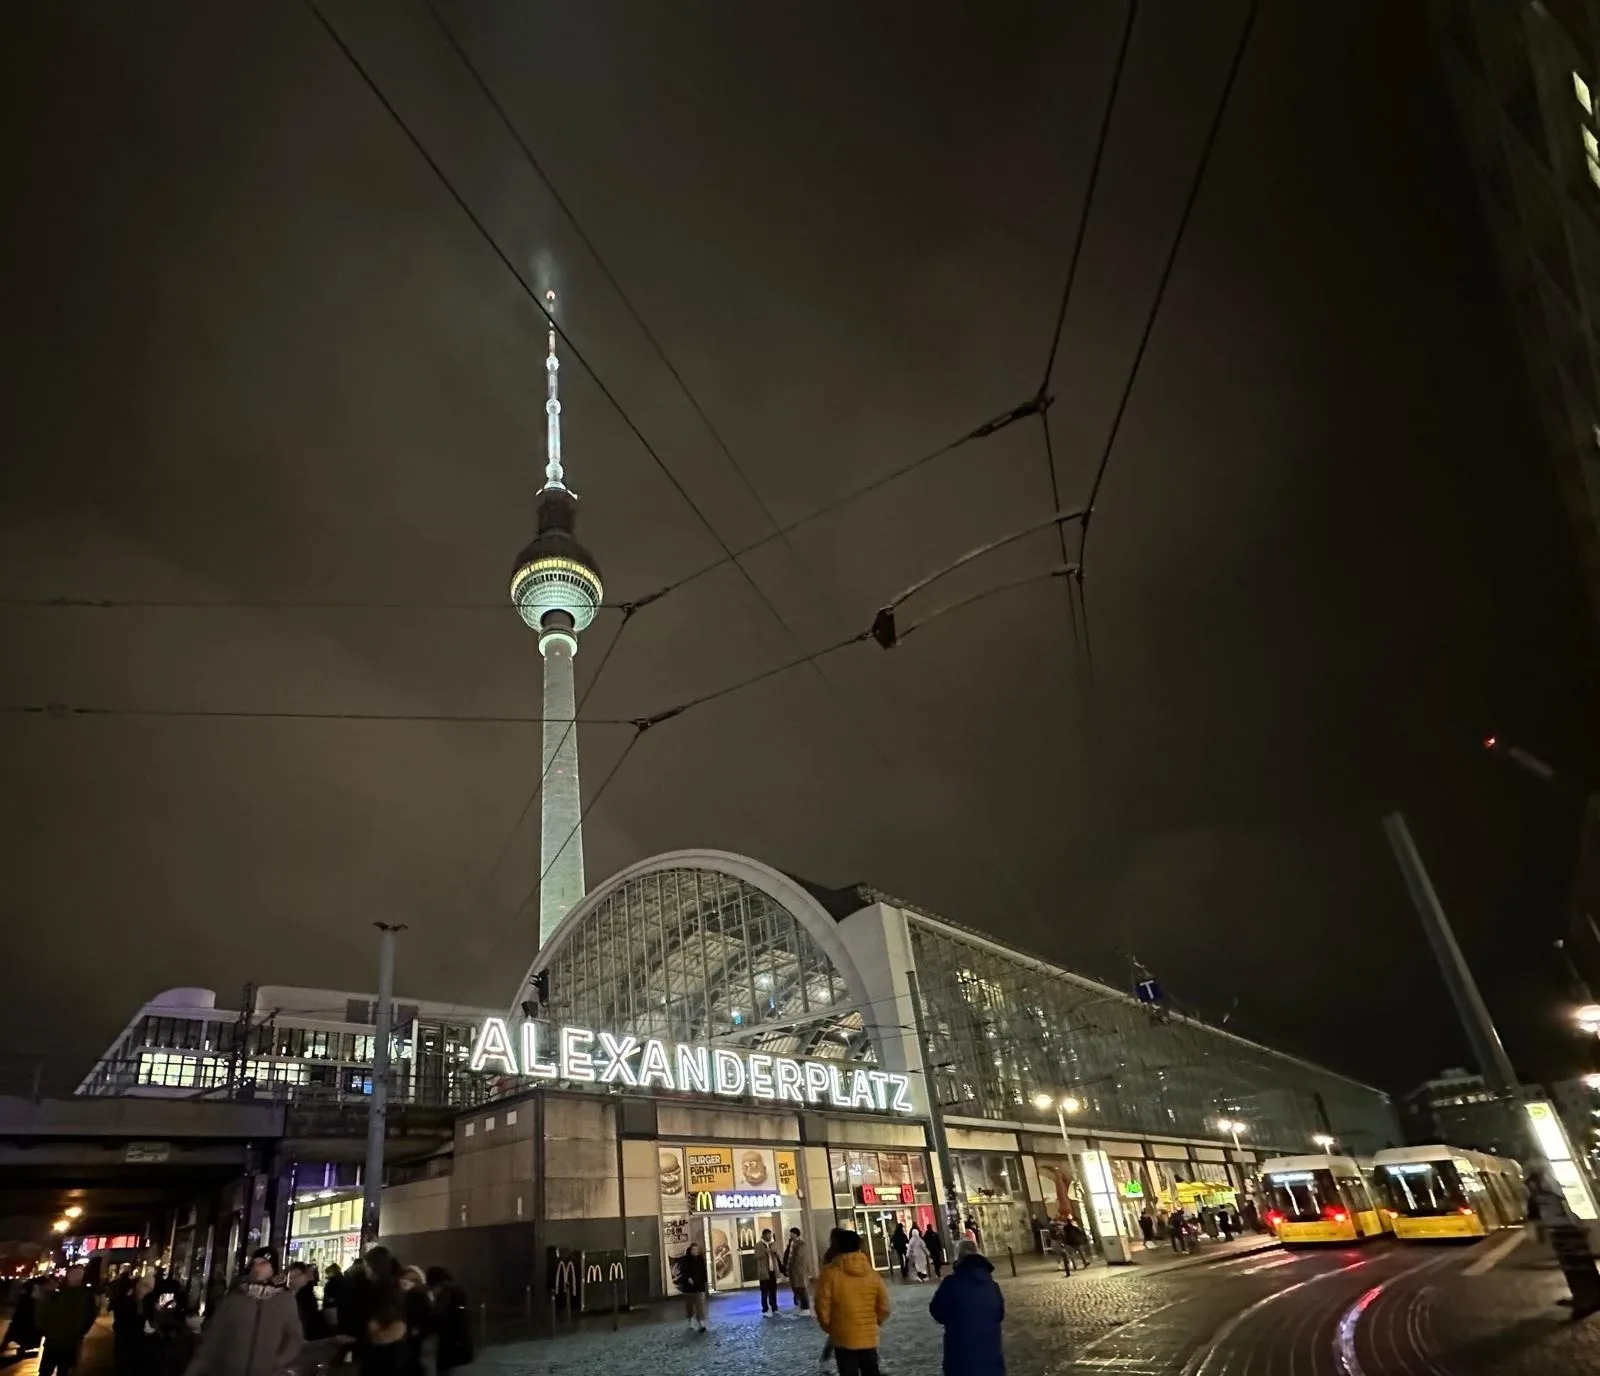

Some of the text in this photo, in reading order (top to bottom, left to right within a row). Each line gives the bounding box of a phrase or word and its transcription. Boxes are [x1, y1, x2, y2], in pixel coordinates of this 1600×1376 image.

[470, 1016, 913, 1112] ALEXANDERPLATZ
[689, 1155, 721, 1165] BURGER
[690, 1164, 731, 1175] FÜR MITTE?
[779, 1169, 795, 1177] LIEBE
[691, 1175, 715, 1184] BITTE!
[715, 1193, 783, 1209] McDonald's
